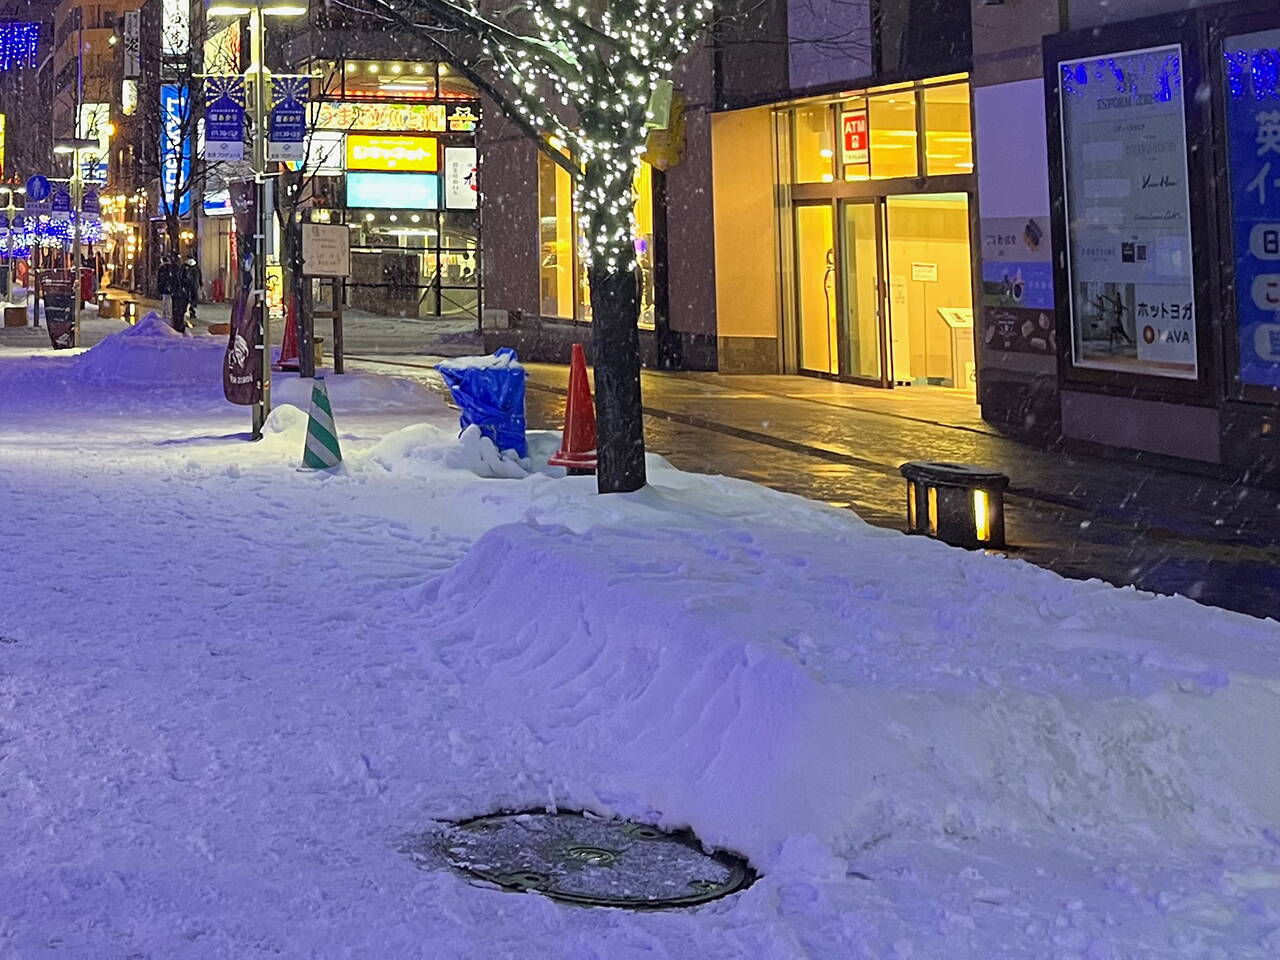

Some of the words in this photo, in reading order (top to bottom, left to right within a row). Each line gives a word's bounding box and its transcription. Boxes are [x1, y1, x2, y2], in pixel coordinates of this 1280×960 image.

[844, 119, 866, 135] ATM
[1137, 301, 1193, 321] ホットヨガ
